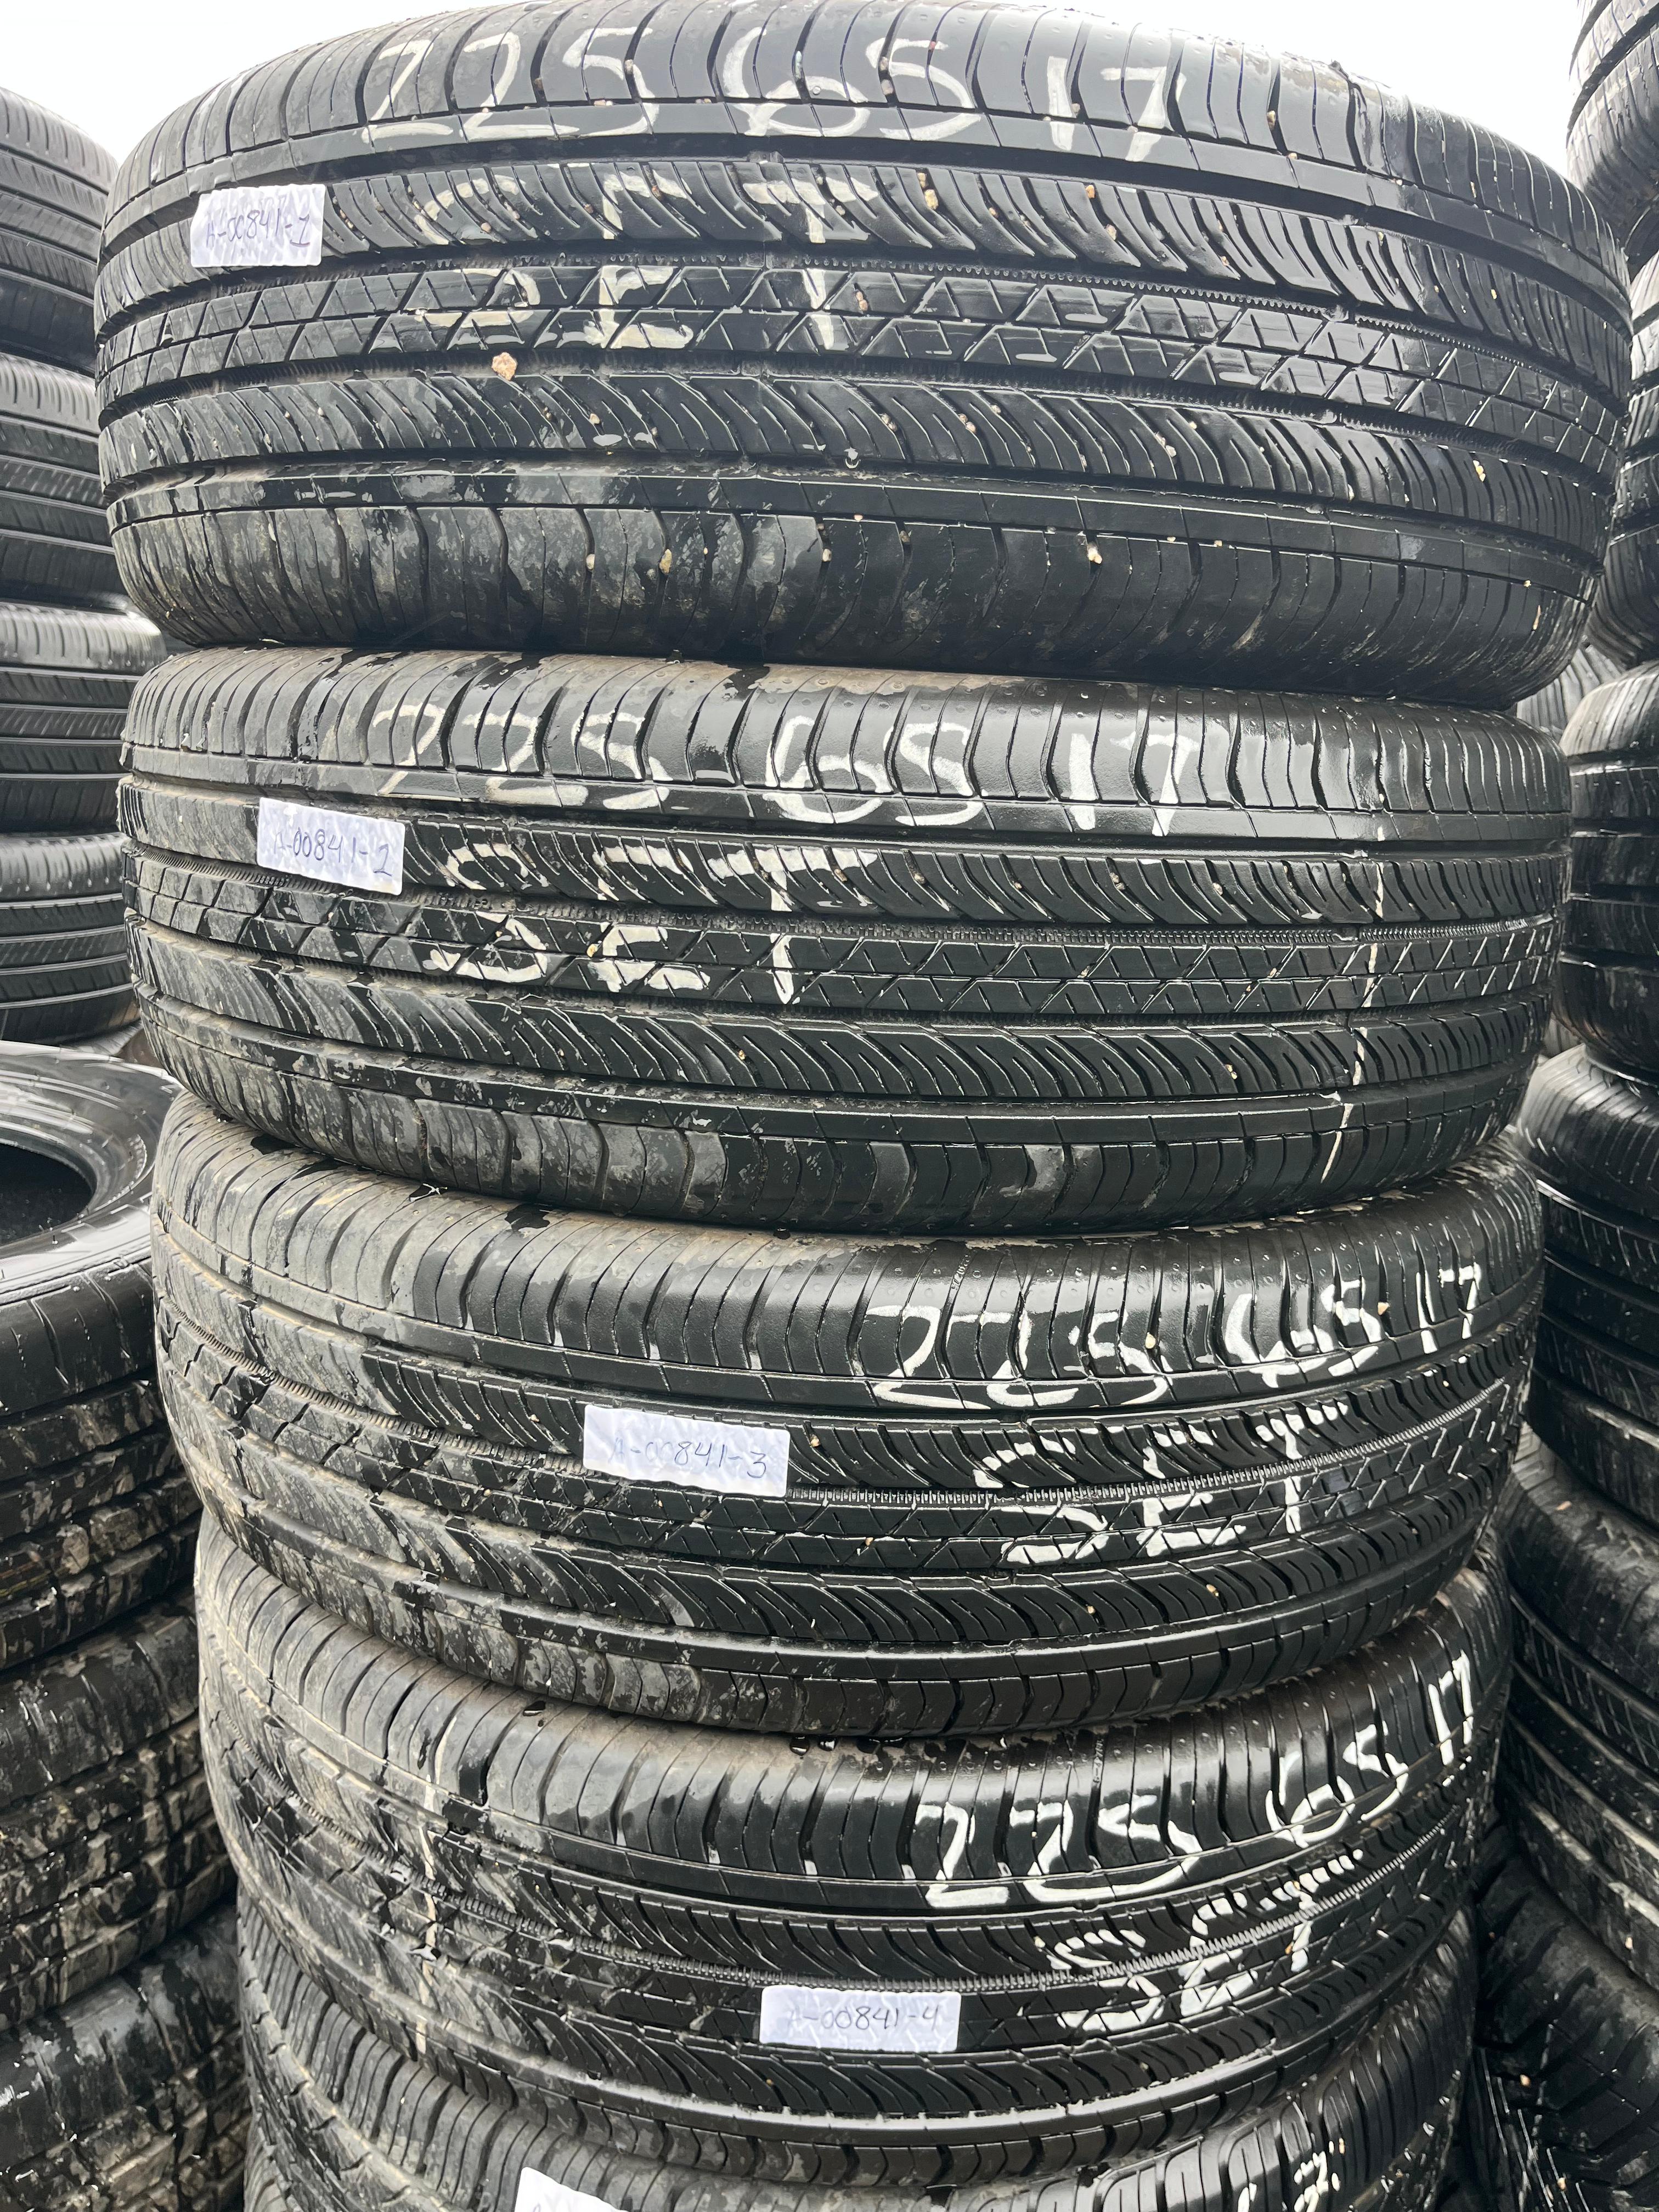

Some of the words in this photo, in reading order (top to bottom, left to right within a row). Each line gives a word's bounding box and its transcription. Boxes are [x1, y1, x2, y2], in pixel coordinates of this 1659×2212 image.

[361, 26, 660, 143] 225
[723, 26, 981, 141] 65
[1048, 55, 1187, 162] 17
[372, 703, 673, 811] 225
[763, 714, 984, 826] 65
[1068, 732, 1199, 837] 17
[866, 1305, 1173, 1410] 225
[1225, 1277, 1381, 1389] 65
[1417, 1262, 1481, 1353] 17
[608, 1437, 766, 1479] A-00841-3
[915, 1793, 1203, 1907] 225
[1265, 1720, 1408, 1848] 65
[1429, 1650, 1474, 1766] 17
